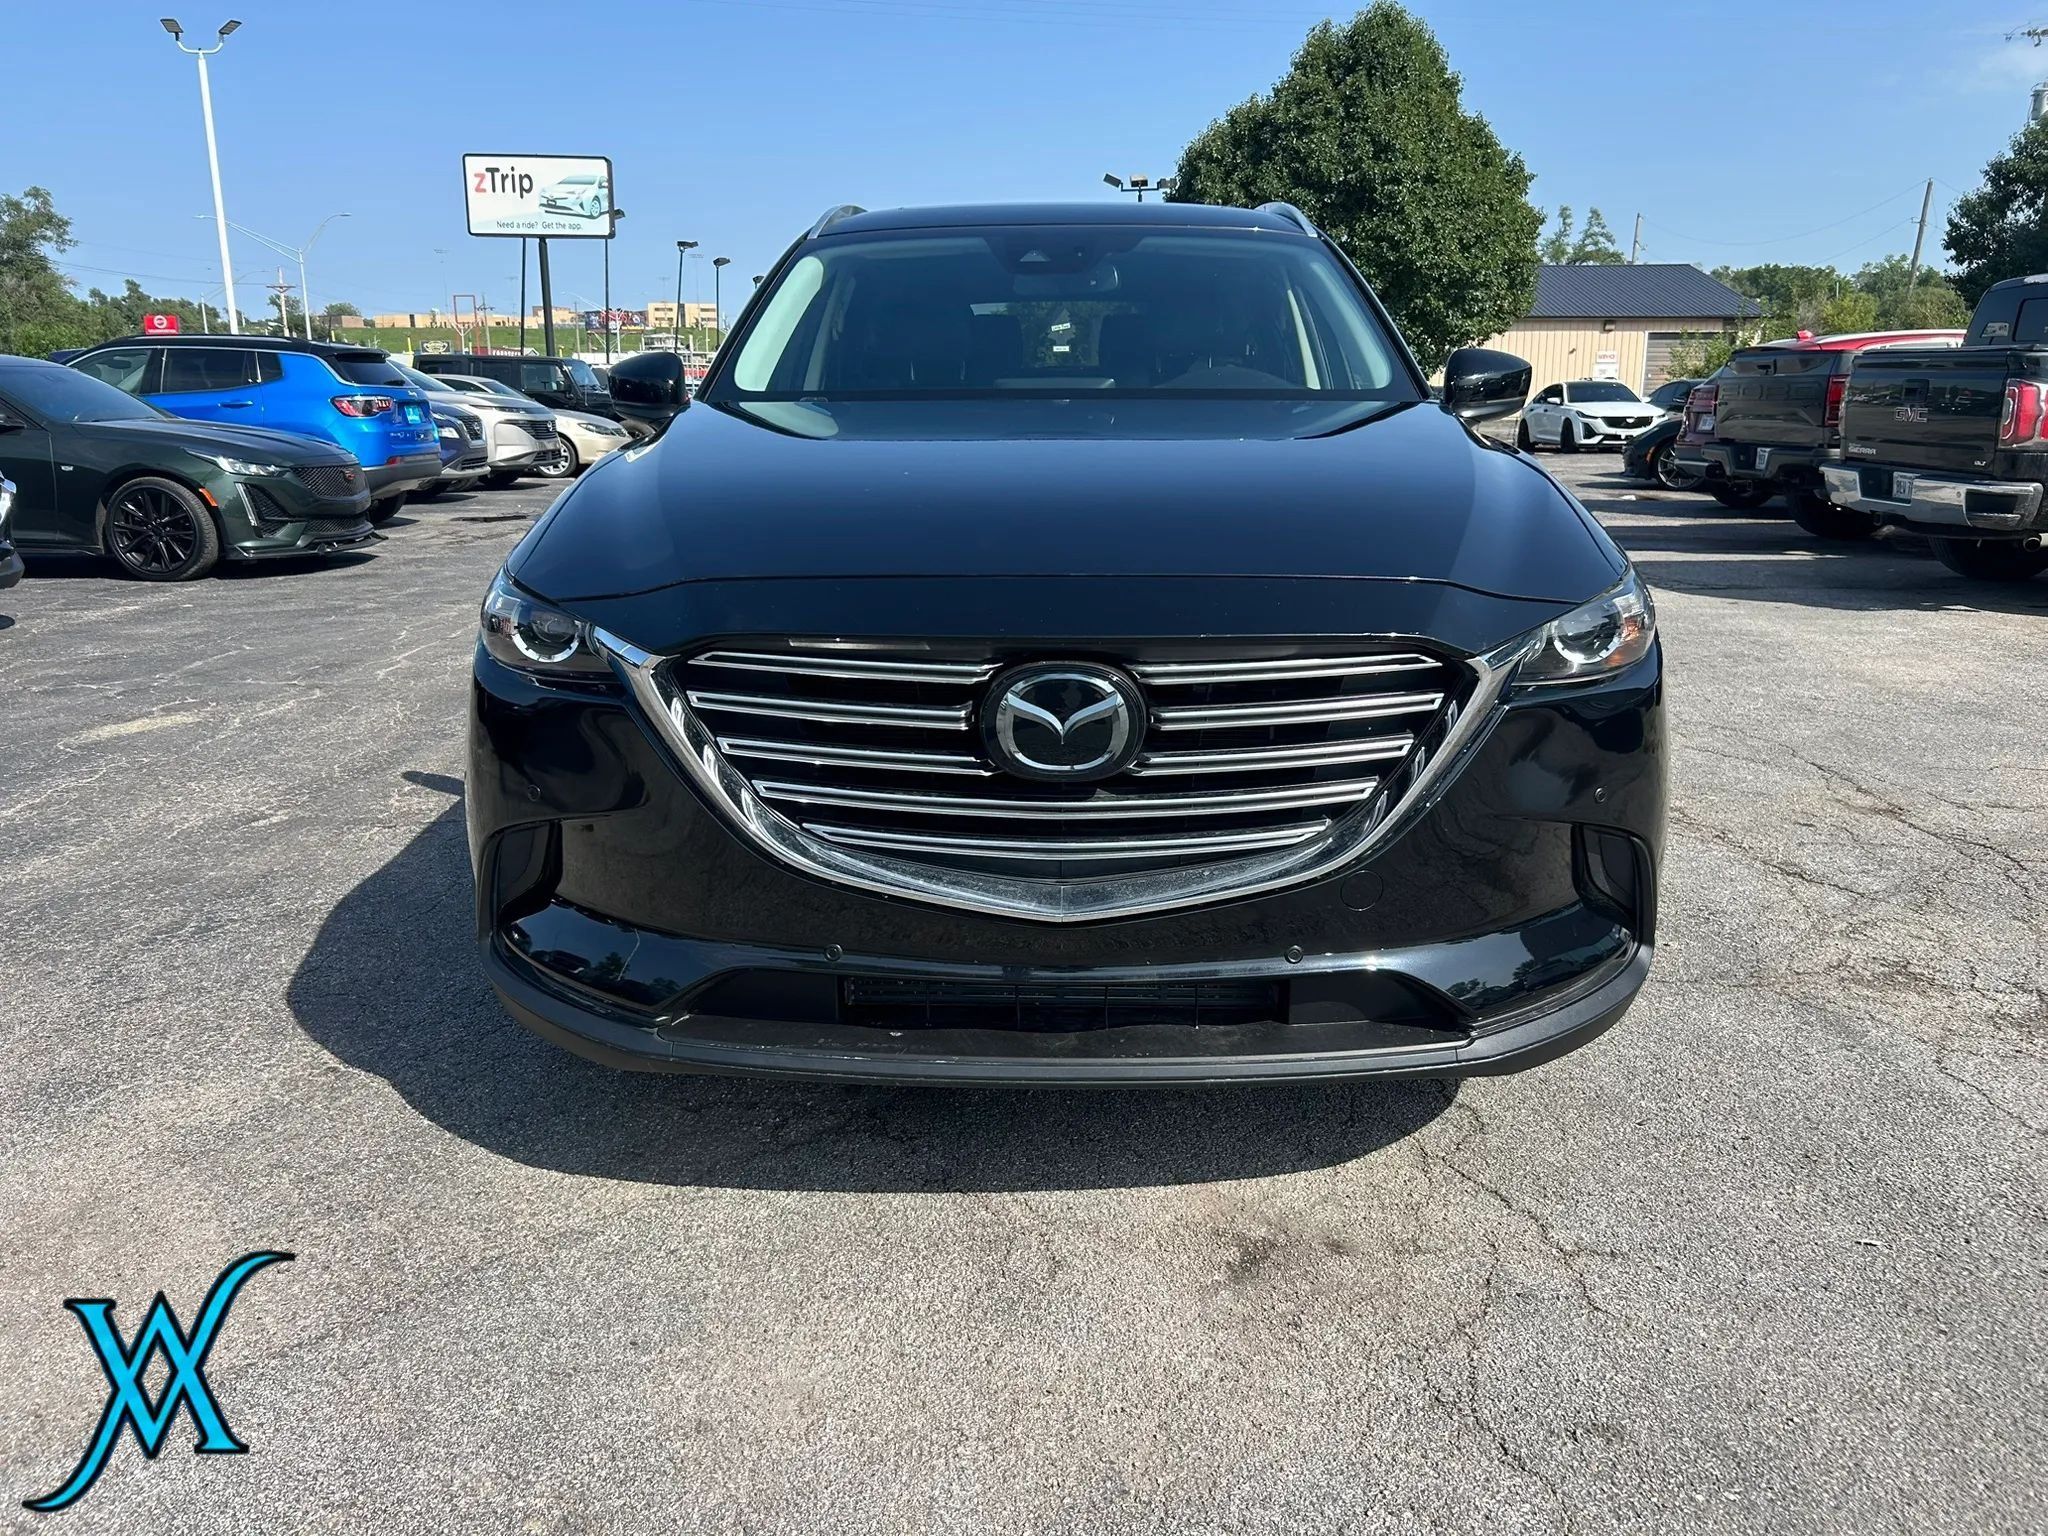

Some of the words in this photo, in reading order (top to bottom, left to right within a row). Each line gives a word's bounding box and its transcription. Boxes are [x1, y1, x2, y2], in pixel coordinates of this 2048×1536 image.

[474, 166, 534, 200] zTrip
[496, 221, 514, 229] Need
[521, 221, 539, 229] ride?
[541, 221, 554, 229] Get
[555, 221, 566, 229] the
[568, 222, 583, 231] app.
[1895, 406, 1929, 423] GMC
